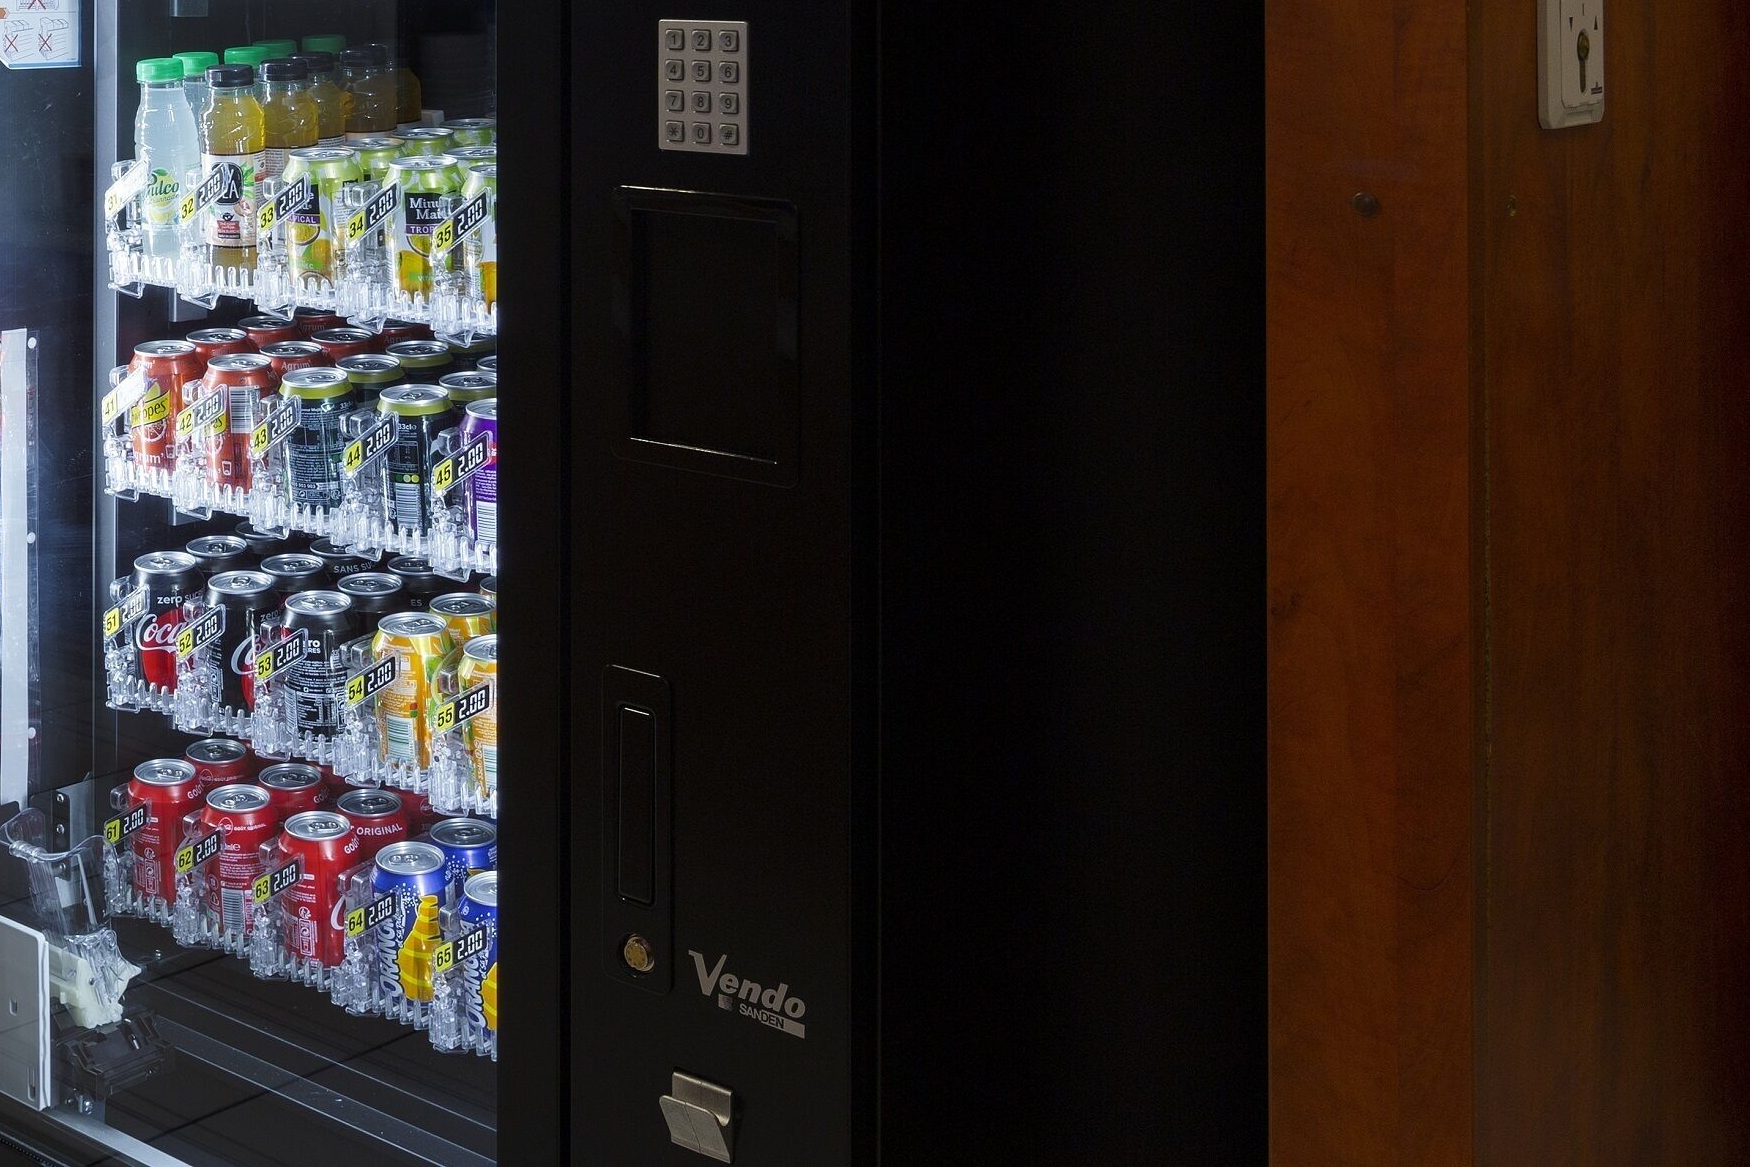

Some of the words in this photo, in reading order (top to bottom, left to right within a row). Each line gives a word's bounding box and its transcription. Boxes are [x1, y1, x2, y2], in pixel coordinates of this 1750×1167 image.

[671, 35, 676, 45] 1
[697, 35, 704, 46] 2
[725, 36, 731, 47] 3
[670, 65, 677, 75] 4
[697, 66, 704, 77] 5
[725, 67, 731, 78] 6
[671, 96, 677, 106] 7
[697, 97, 704, 107] 8
[725, 98, 731, 109] 9
[181, 199, 194, 219] 32
[199, 174, 221, 204] 2.00
[260, 209, 273, 229] 33
[279, 182, 302, 213] 2.00
[350, 217, 363, 238] 34
[369, 189, 393, 224] 2.00
[436, 225, 451, 248] 35
[457, 200, 482, 234] 2.00
[179, 413, 191, 431] 42
[197, 395, 218, 422] 2.00
[254, 433, 266, 449] 43
[270, 410, 293, 439] 2.00
[347, 449, 361, 466] 44
[366, 424, 390, 457] 2.00
[436, 465, 451, 486] 45
[458, 442, 483, 476] 2.00
[106, 614, 117, 630] 51
[121, 597, 141, 621] 2.00
[157, 596, 182, 605] zero
[179, 634, 191, 652] 52
[196, 616, 217, 644] 2.00
[258, 661, 271, 676] 53
[276, 638, 299, 667] 2.00
[349, 683, 363, 700] 54
[368, 662, 391, 693] 2.00
[438, 708, 453, 727] 55
[458, 690, 486, 719] 2.00
[107, 825, 118, 840] 61
[123, 808, 143, 834] 2.00
[356, 823, 403, 836] ORIGINAL
[179, 851, 191, 868] 62
[197, 835, 217, 862] 2.00
[255, 881, 269, 898] 63
[274, 865, 296, 891] 2.00
[348, 915, 363, 932] 64
[368, 896, 392, 926] 2.00
[436, 948, 451, 967] 65
[457, 931, 483, 960] 2.00
[688, 950, 806, 1018] Vendo
[739, 1003, 784, 1029] SANDEN
